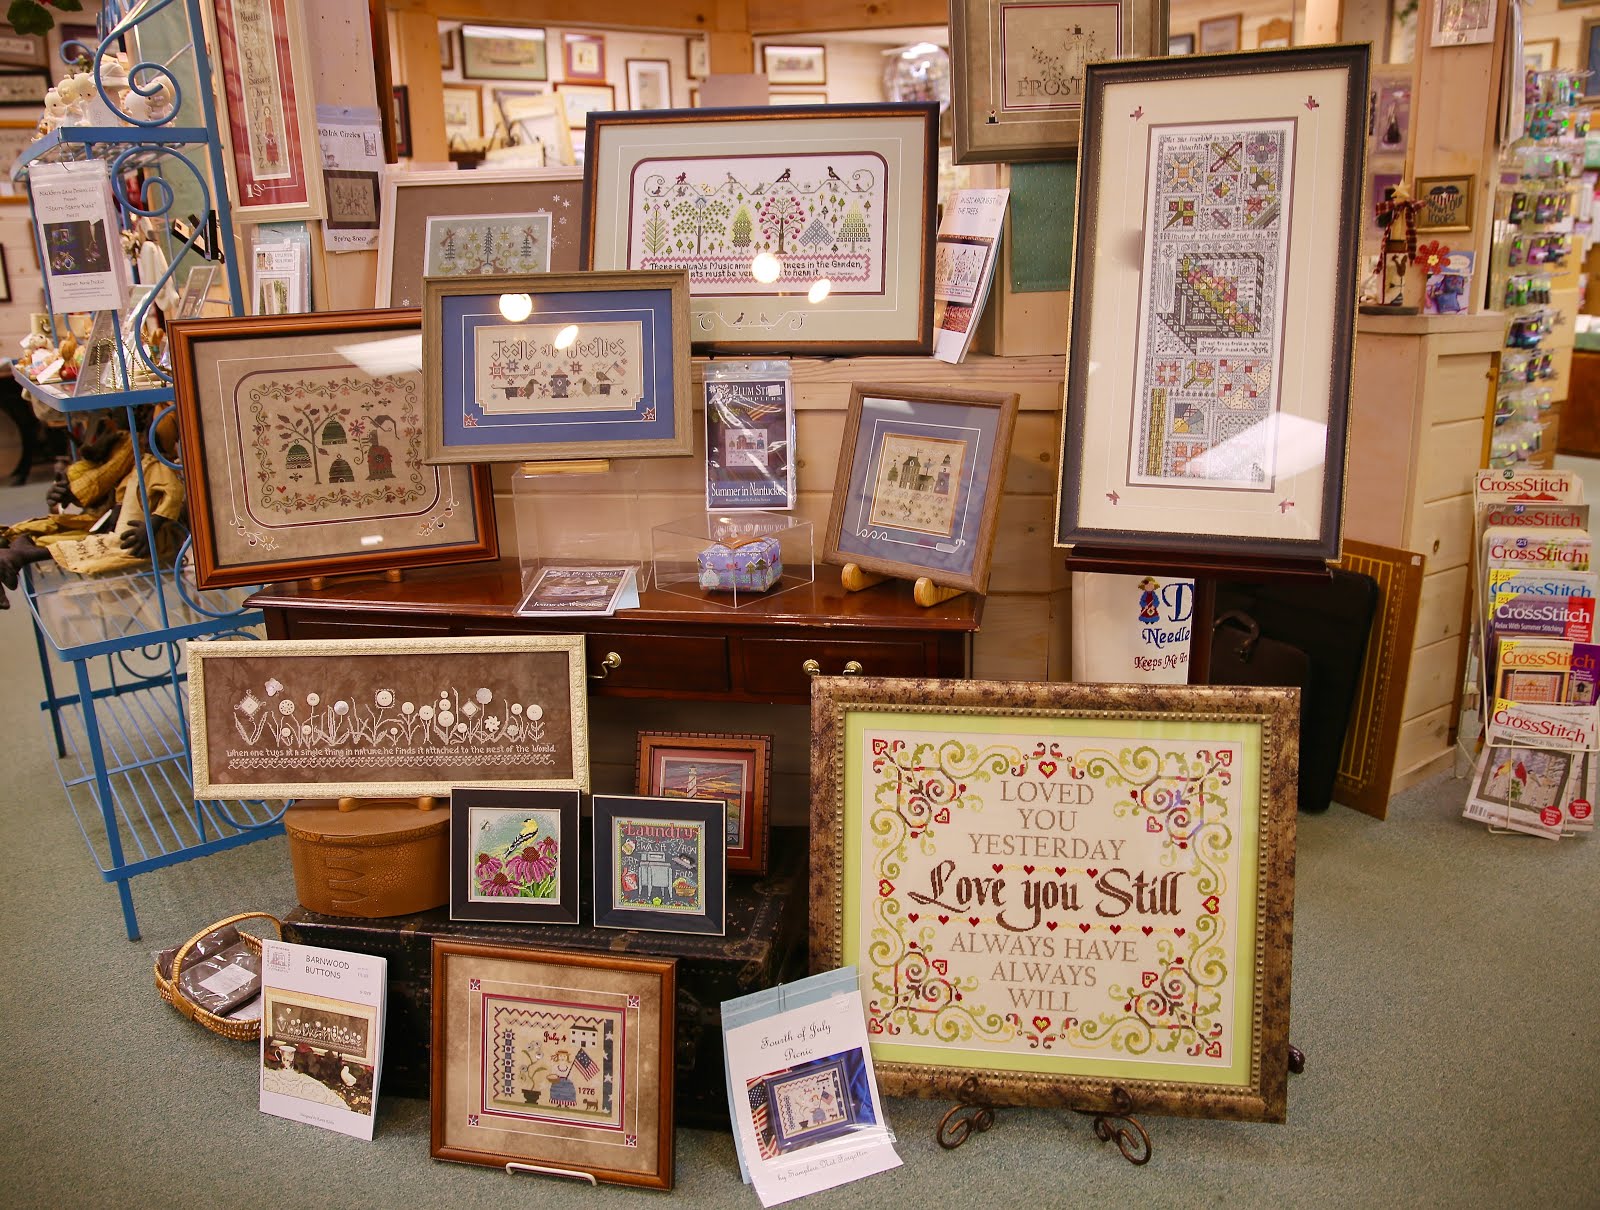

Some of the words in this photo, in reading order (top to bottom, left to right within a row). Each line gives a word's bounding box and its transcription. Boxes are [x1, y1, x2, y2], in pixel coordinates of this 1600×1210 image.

[1016, 77, 1082, 98] FROST
[832, 260, 862, 269] Garden,
[491, 340, 536, 361] Jeans
[566, 336, 626, 359] Weenies
[732, 385, 754, 396] PLUM
[756, 385, 784, 396] STT
[712, 482, 741, 496] Summer
[742, 486, 748, 496] in
[750, 481, 786, 496] Nantucke
[1480, 477, 1569, 492] CrossStitch
[1488, 511, 1581, 527] CrossStitch
[1491, 545, 1584, 562] CrossStitch
[1498, 581, 1591, 597] CrossStitch
[1496, 604, 1590, 623] CrossStitch
[1142, 626, 1190, 649] Needle
[1542, 624, 1564, 634] Stitching
[1134, 656, 1162, 671] Keeps
[1163, 654, 1177, 669] Me
[1502, 651, 1595, 669] CrossStitch
[1494, 710, 1585, 743] CrossStitch
[265, 748, 284, 758] tugs
[301, 748, 323, 757] single
[324, 748, 344, 757] thing
[383, 747, 394, 755] he
[395, 747, 416, 755] finds
[417, 746, 424, 754] it
[425, 745, 459, 754] attached
[461, 746, 468, 754] to
[471, 746, 485, 754] the
[486, 745, 505, 753] rest
[506, 745, 514, 753] of
[516, 744, 529, 752] the
[1000, 780, 1095, 806] LOVED
[1018, 808, 1078, 832] YOU
[627, 820, 694, 840] Laundry
[641, 842, 667, 852] WASH
[968, 833, 1126, 861] YESTERDAY
[907, 860, 1006, 914] Love
[996, 879, 1084, 932] you
[1095, 868, 1186, 918] Still
[950, 932, 1056, 958] ALWAYS
[1064, 938, 1140, 962] HAVE
[306, 954, 350, 970] BARNWOOD
[305, 966, 341, 979] BUTTONS
[990, 962, 1097, 987] ALWAYS
[1008, 988, 1079, 1013] WILL
[544, 1031, 560, 1045] July
[760, 1030, 793, 1050] Fourth
[797, 1026, 806, 1042] of
[809, 1020, 832, 1039] July
[784, 1047, 814, 1061] Picnic
[578, 1087, 596, 1096] 1776
[778, 1174, 787, 1182] by
[787, 1165, 818, 1178] Samplers
[837, 1151, 868, 1163] Forgotten
